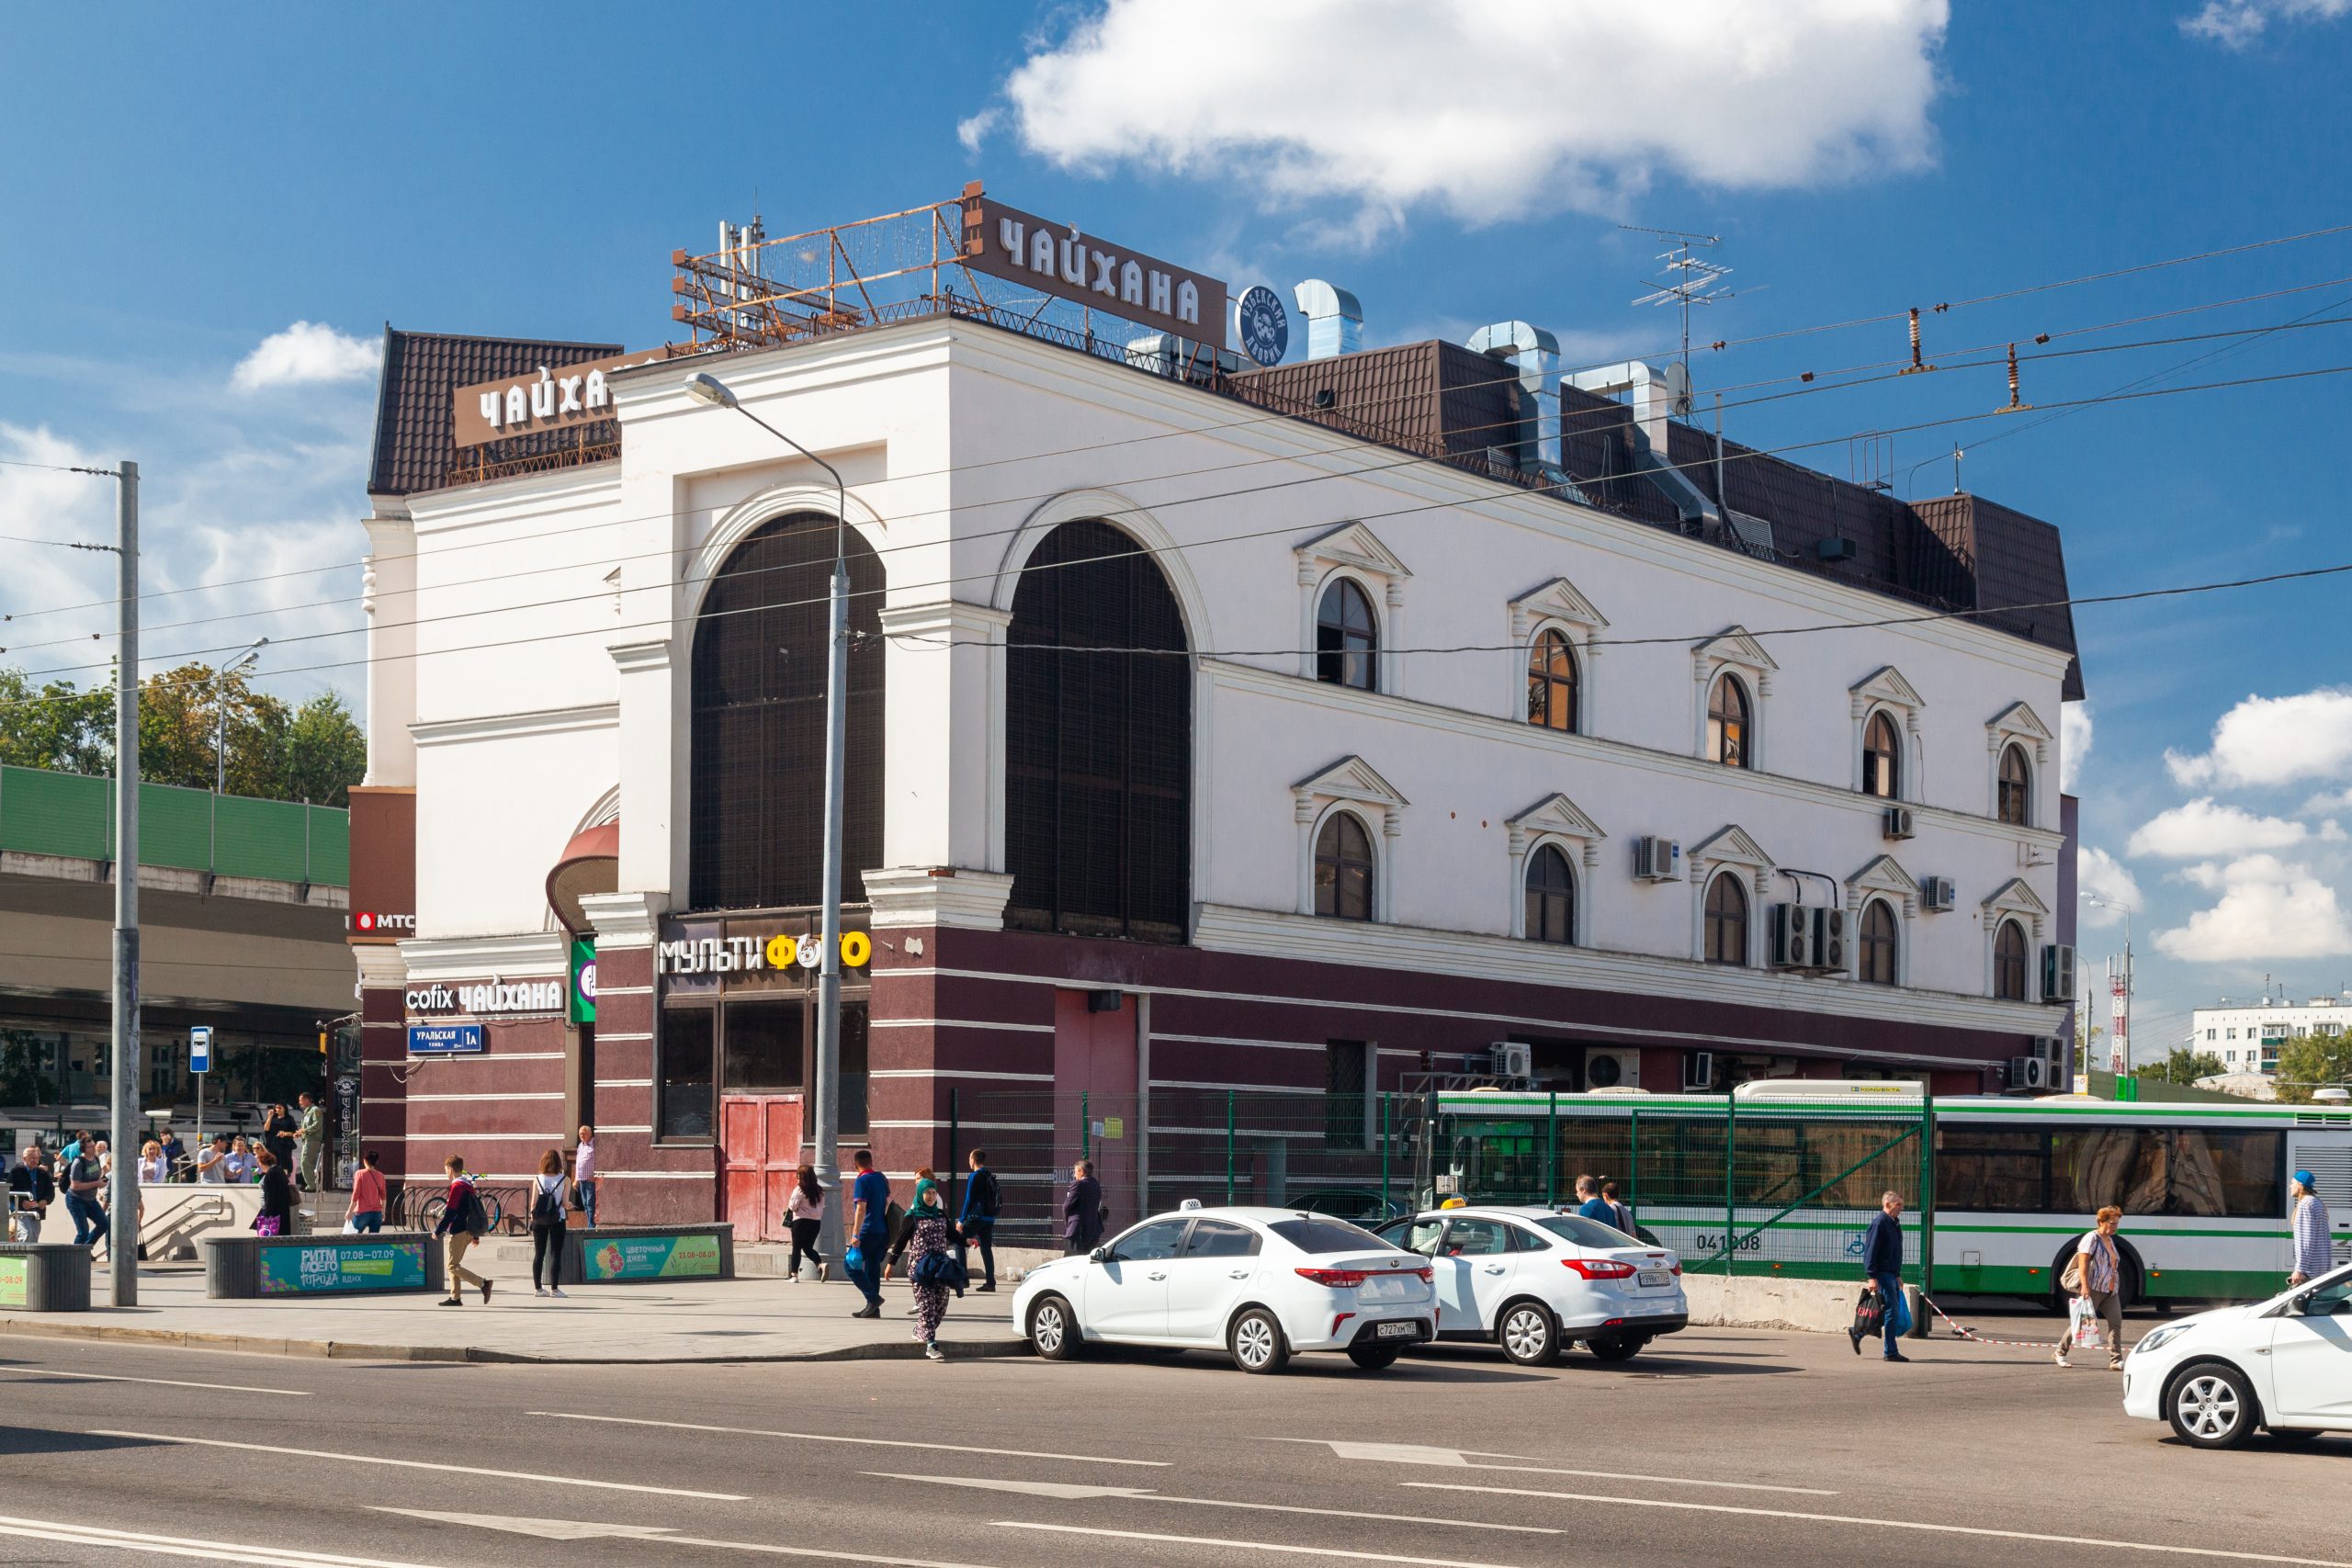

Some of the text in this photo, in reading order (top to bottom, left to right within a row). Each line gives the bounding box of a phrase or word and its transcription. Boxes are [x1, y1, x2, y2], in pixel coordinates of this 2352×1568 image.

[999, 221, 1199, 324] ЧАЙХАНА
[1246, 335, 1282, 363] ДВОРИК
[480, 357, 658, 427] ЧАЙХА
[378, 914, 415, 930] МТС
[406, 984, 456, 1010] cofix
[459, 973, 563, 1012] ЧАЙХАНА
[416, 1031, 457, 1041] УРАЛЬСКАЯ
[301, 1248, 337, 1261] РИТМ
[626, 1244, 666, 1253] ЦВЕТОЧНЫЙ
[626, 1255, 648, 1263] ДЖЕМ
[300, 1261, 339, 1273] МОЕГО
[342, 1275, 362, 1283] ВДНХ
